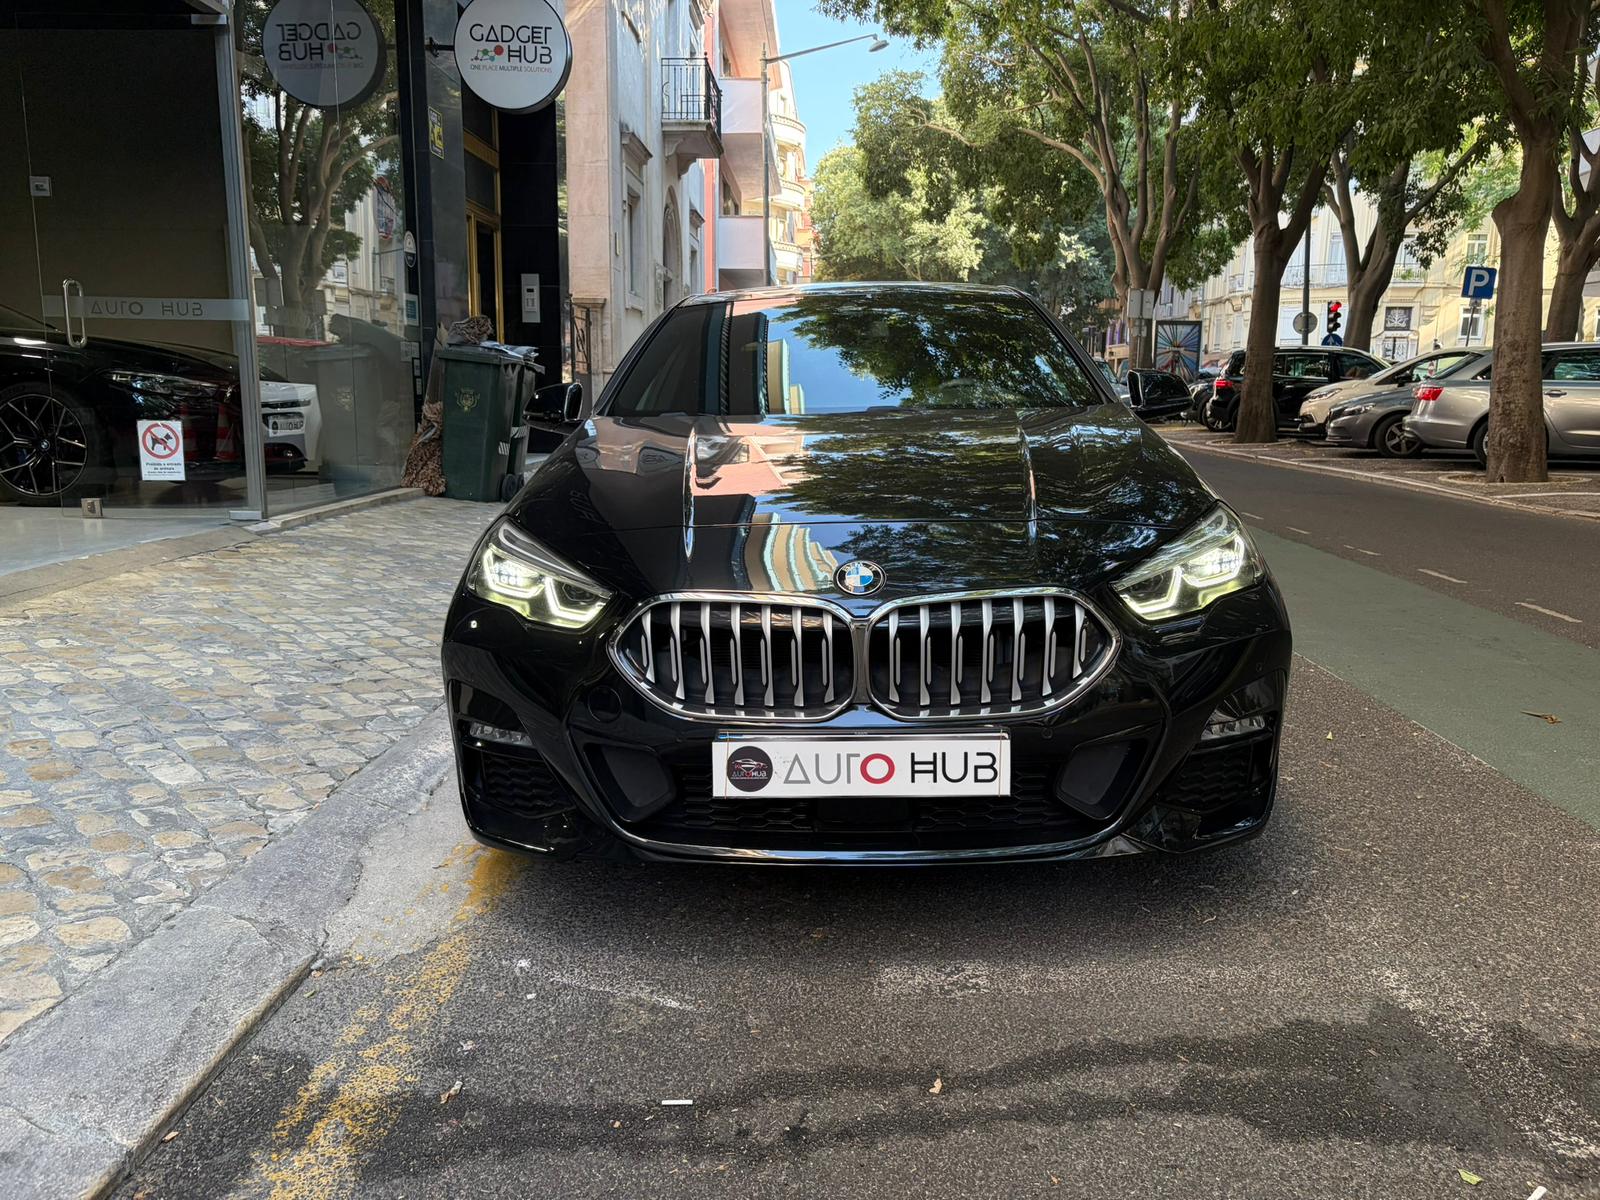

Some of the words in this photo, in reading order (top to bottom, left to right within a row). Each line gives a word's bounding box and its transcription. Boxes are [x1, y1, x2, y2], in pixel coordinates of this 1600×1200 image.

[469, 23, 553, 45] GADGET
[507, 44, 553, 65] HUB
[482, 64, 498, 72] PLACE
[499, 65, 523, 73] MULTIPLE
[524, 66, 552, 74] SOLUTIONS
[1467, 269, 1490, 296] P
[91, 300, 144, 316] AUTO
[161, 301, 203, 317] HUB
[783, 753, 895, 784] AUTO
[910, 751, 998, 783] HUB
